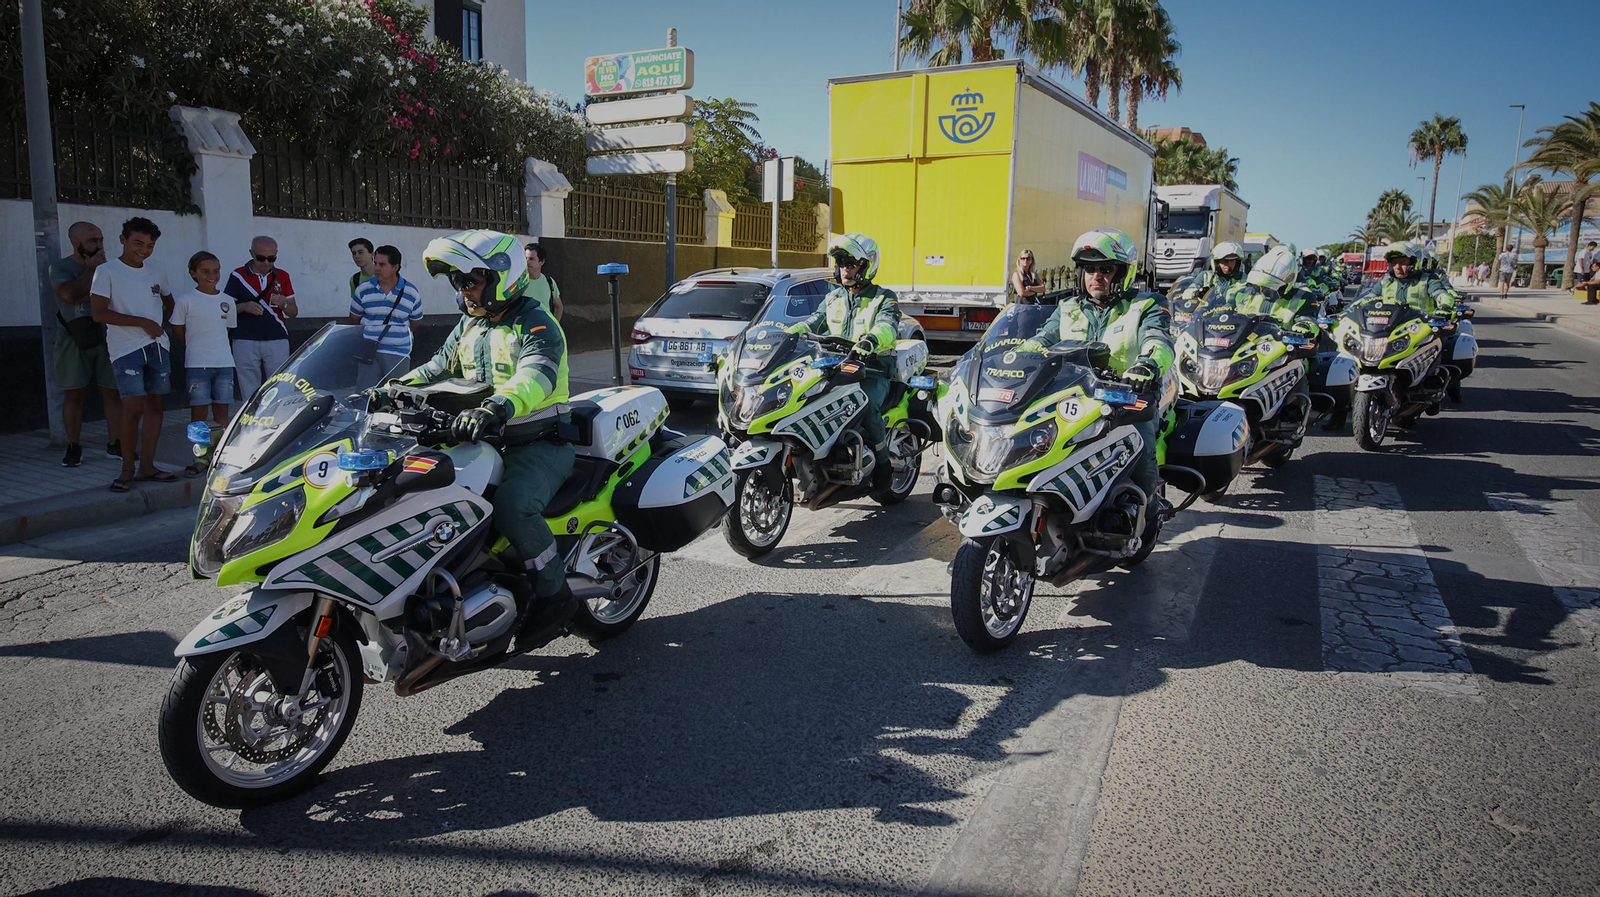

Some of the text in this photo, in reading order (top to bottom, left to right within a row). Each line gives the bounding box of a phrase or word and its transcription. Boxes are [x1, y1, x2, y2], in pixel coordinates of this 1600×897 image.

[635, 52, 682, 64] ANÚNCIATE
[598, 65, 617, 74] TE VEN
[637, 61, 680, 76] AQUÍ
[642, 77, 654, 88] 619
[655, 76, 668, 86] 472
[1261, 344, 1270, 352] 46
[793, 367, 805, 378] 35
[986, 367, 1024, 378] TRAFICO
[295, 378, 316, 402] CIVIL
[1065, 402, 1078, 416] 15
[622, 409, 641, 429] 062
[318, 461, 329, 478] 9
